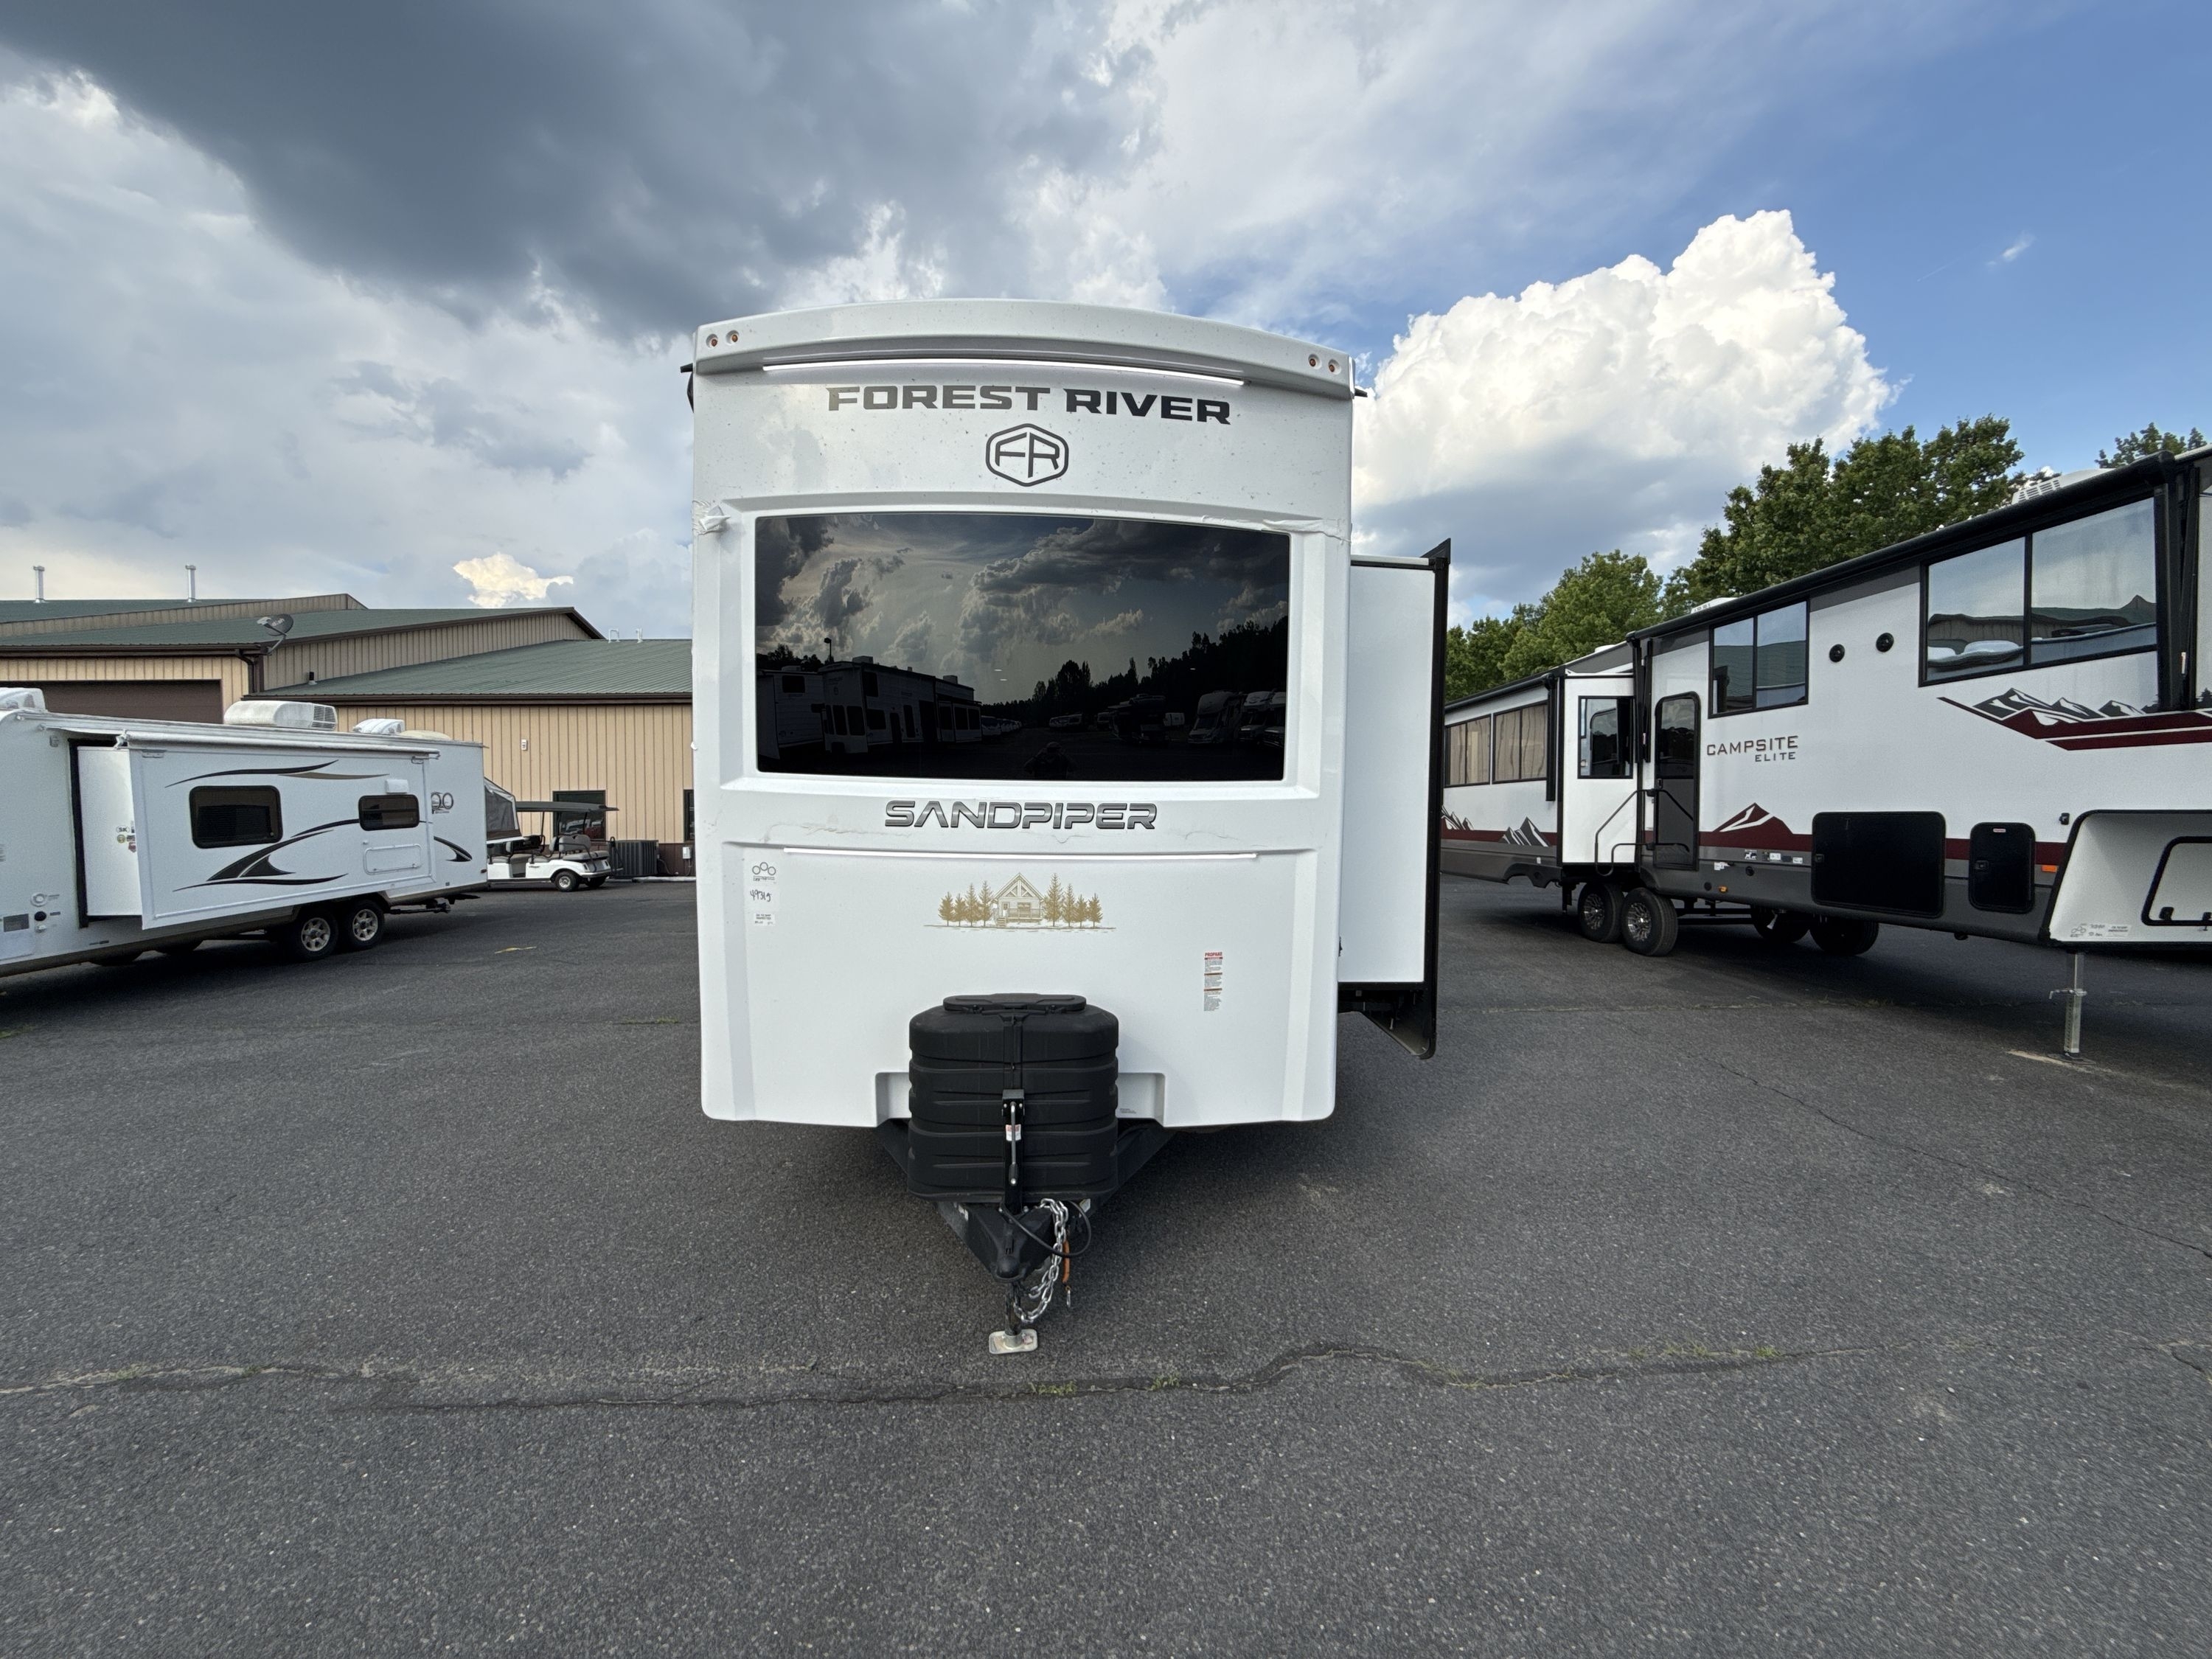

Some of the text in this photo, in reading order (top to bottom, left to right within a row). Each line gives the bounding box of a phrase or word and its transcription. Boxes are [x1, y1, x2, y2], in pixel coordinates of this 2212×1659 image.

[825, 385, 1231, 425] FOREST RIVER
[1706, 735, 1798, 756] CAMPSITE
[1755, 751, 1796, 762] ELITE
[885, 800, 1158, 830] SANDPIPER
